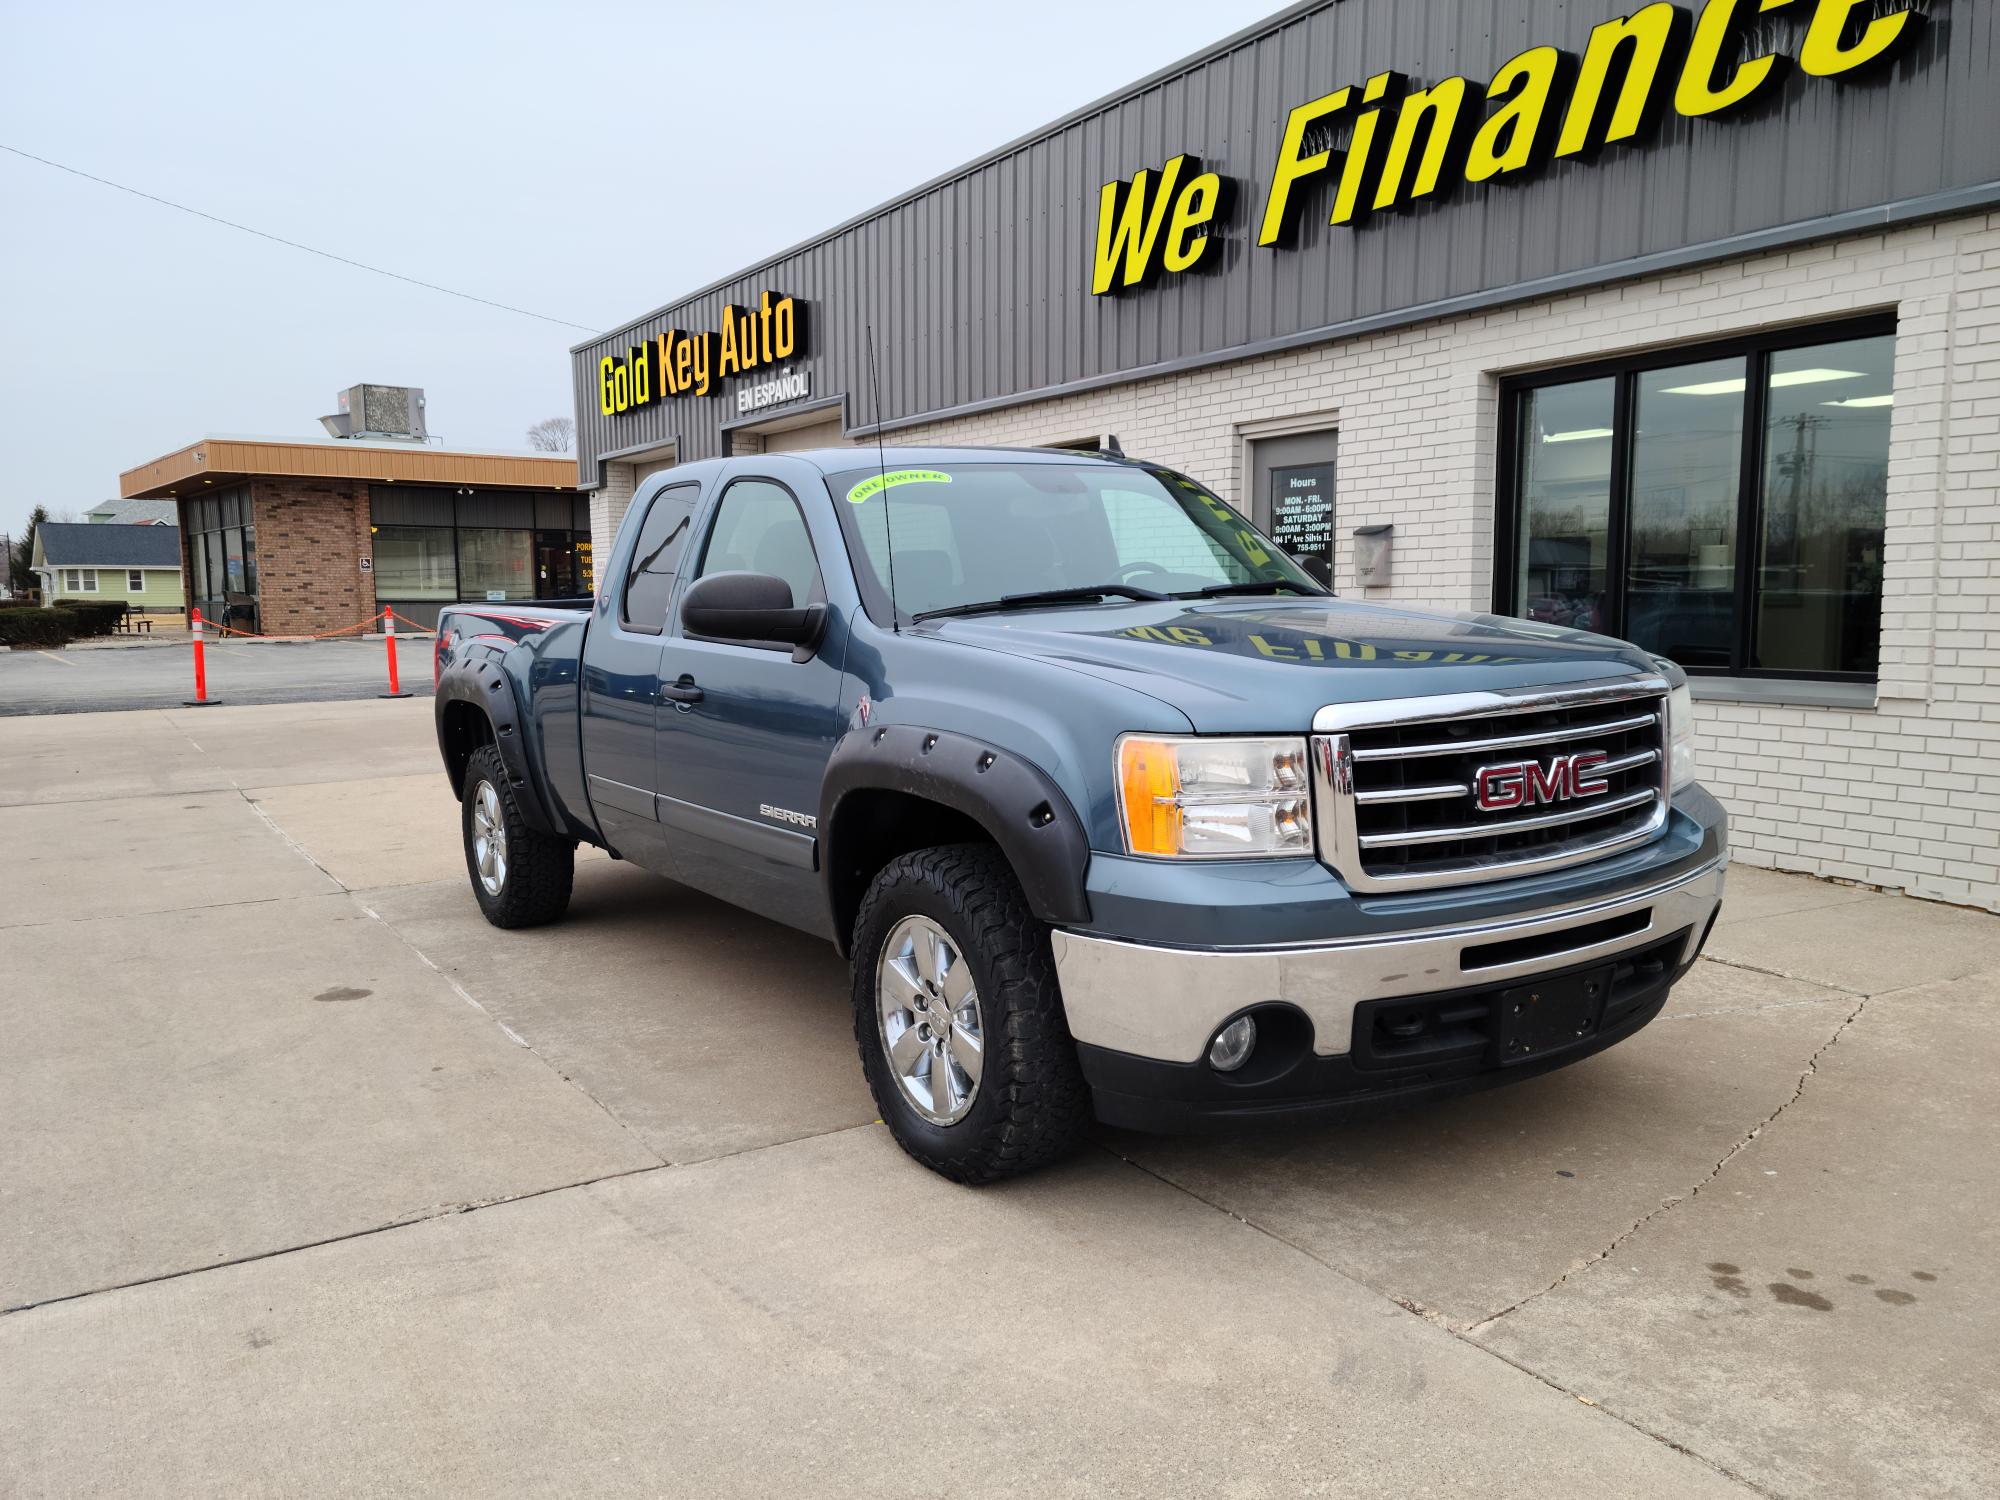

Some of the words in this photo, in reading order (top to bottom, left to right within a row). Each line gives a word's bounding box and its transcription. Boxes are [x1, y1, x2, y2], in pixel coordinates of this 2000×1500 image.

[1091, 152, 1220, 297] We
[600, 340, 650, 417] Gold
[658, 328, 709, 397] Key
[719, 290, 795, 378] Auto
[738, 390, 753, 412] EN
[755, 368, 809, 406] ESPAÑOL
[854, 481, 880, 498] ONE
[886, 473, 943, 483] OWNER
[1290, 478, 1317, 488] Hours
[1275, 506, 1301, 515] 9:00AM
[1306, 503, 1332, 513] 6:00PM
[1284, 496, 1303, 505] MON.
[1308, 495, 1322, 503] FRI.
[1275, 525, 1301, 534] 9:00AM
[1305, 522, 1332, 532] 3:00PM
[1283, 514, 1323, 524] SATURDAY
[1292, 535, 1304, 543] Ave
[1304, 532, 1322, 542] Silvis
[1474, 750, 1609, 812] GMC
[759, 803, 817, 829] SIERRA
